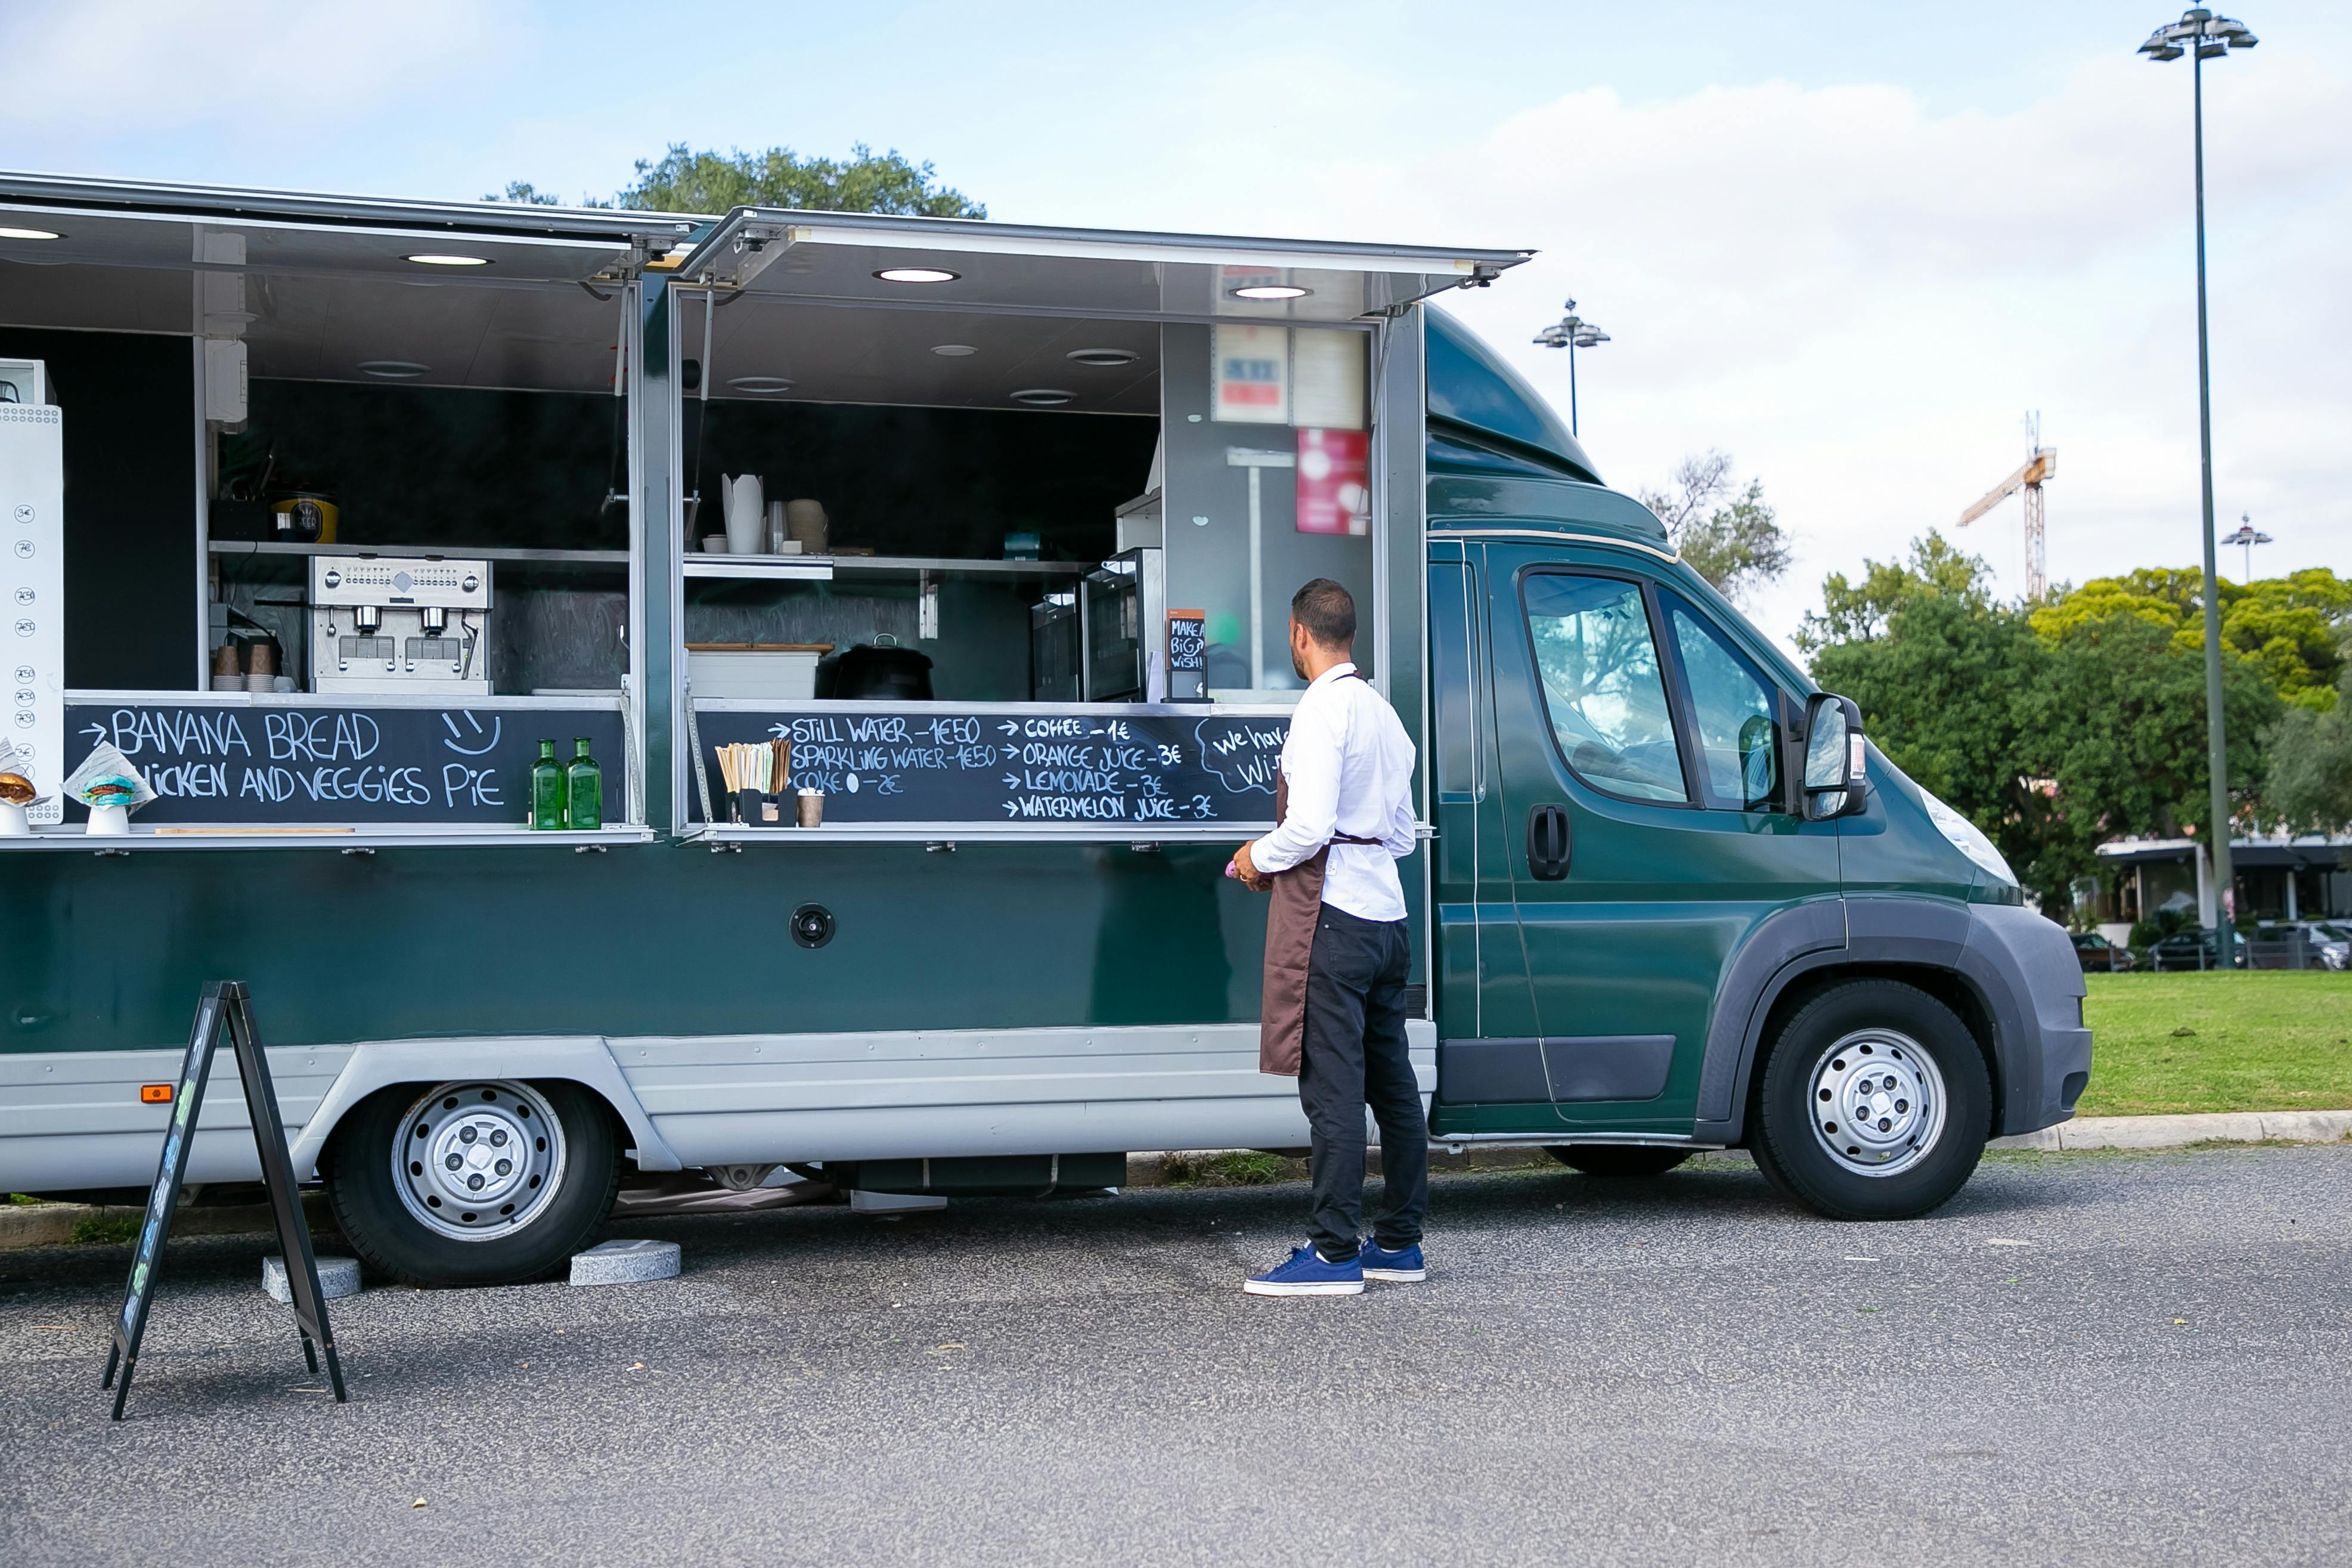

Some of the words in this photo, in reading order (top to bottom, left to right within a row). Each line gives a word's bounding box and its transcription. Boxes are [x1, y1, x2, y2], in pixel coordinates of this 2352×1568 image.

[1172, 620, 1198, 637] MAKE
[112, 709, 251, 757] BANANA
[265, 712, 379, 762] BREAD
[846, 717, 913, 744] WATER
[1025, 718, 1082, 737] COFFEE
[1023, 743, 1093, 769] ORANGE
[240, 766, 295, 802] AND
[793, 770, 844, 794] COKE
[1025, 770, 1125, 794] LEMONADE
[1018, 795, 1126, 819] WATERMELON
